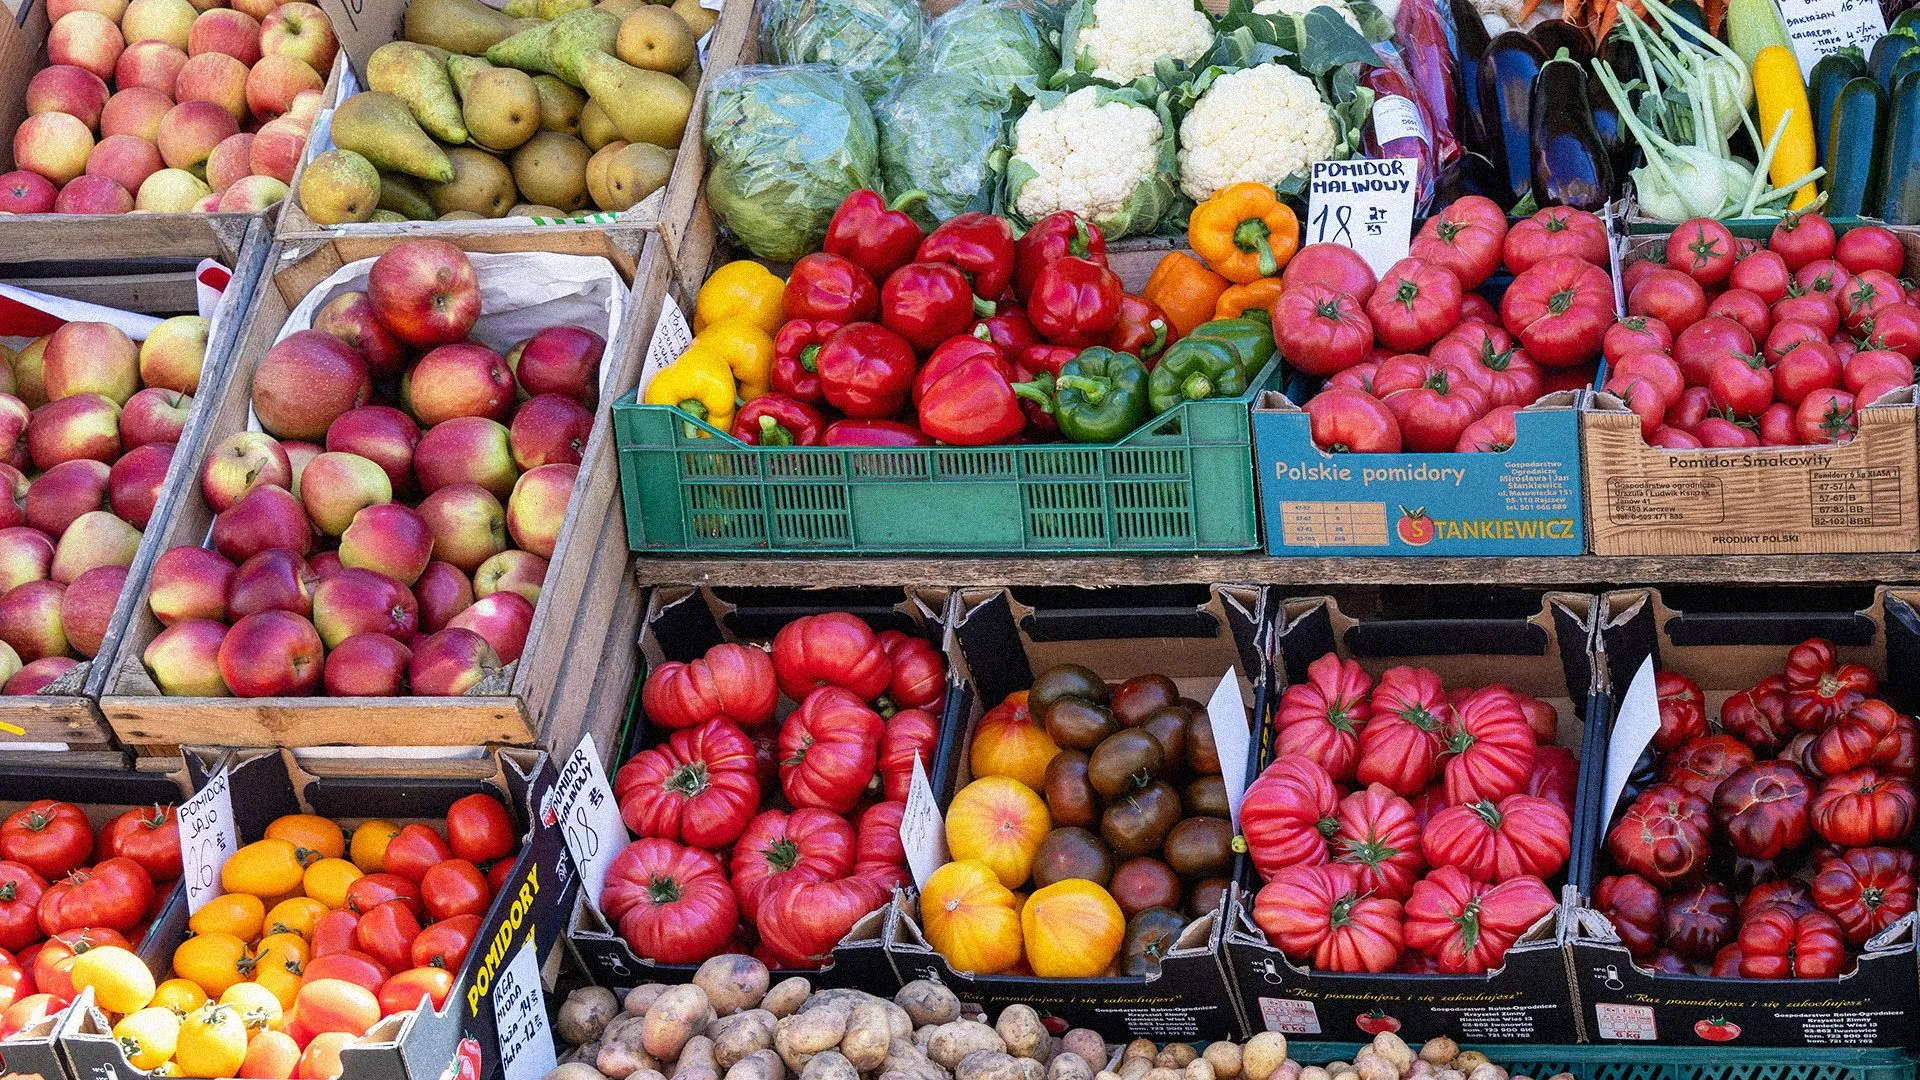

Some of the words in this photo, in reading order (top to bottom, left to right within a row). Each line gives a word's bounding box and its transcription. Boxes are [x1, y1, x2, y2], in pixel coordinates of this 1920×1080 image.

[1786, 11, 1835, 27] BAKŁAŻAN
[1314, 160, 1404, 178] POMIDOR
[1313, 180, 1410, 194] MALINOWY
[1313, 204, 1353, 249] 18
[669, 306, 688, 356] Papry
[1505, 461, 1562, 469] Gospodarstwo
[1670, 456, 1737, 469] Pomidor
[1743, 454, 1833, 470] Smakowity
[1275, 461, 1351, 482] Polskie
[1363, 463, 1466, 487] pomidory
[1511, 468, 1556, 476] Ogrodnicze
[1813, 471, 1848, 480] Pomidory
[1867, 470, 1891, 478] KLASA
[1508, 481, 1563, 489] Stankiewicz
[1672, 482, 1716, 490] ogrodnicze
[1650, 489, 1678, 497] Ludwik
[1819, 494, 1845, 502] 57-67
[1814, 517, 1846, 526] 82-102
[1411, 519, 1576, 540] STANKIEWICZ
[1712, 536, 1760, 545] PRODUKT
[1762, 535, 1799, 544] POLSKI
[552, 749, 588, 816] POMIDOR
[181, 775, 226, 823] POMIDOR
[559, 762, 593, 830] MALINOWY
[191, 809, 217, 839] JAJO
[569, 807, 598, 879] 28
[189, 838, 214, 898] 26
[467, 863, 540, 1018] POMIDORY
[1324, 992, 1401, 1002] posmakujesz
[1665, 998, 1745, 1009] posmakujesz
[1488, 1004, 1558, 1012] Rolno-Ogrodnicze
[1281, 1024, 1289, 1032] 6
[1292, 1024, 1307, 1033] kg
